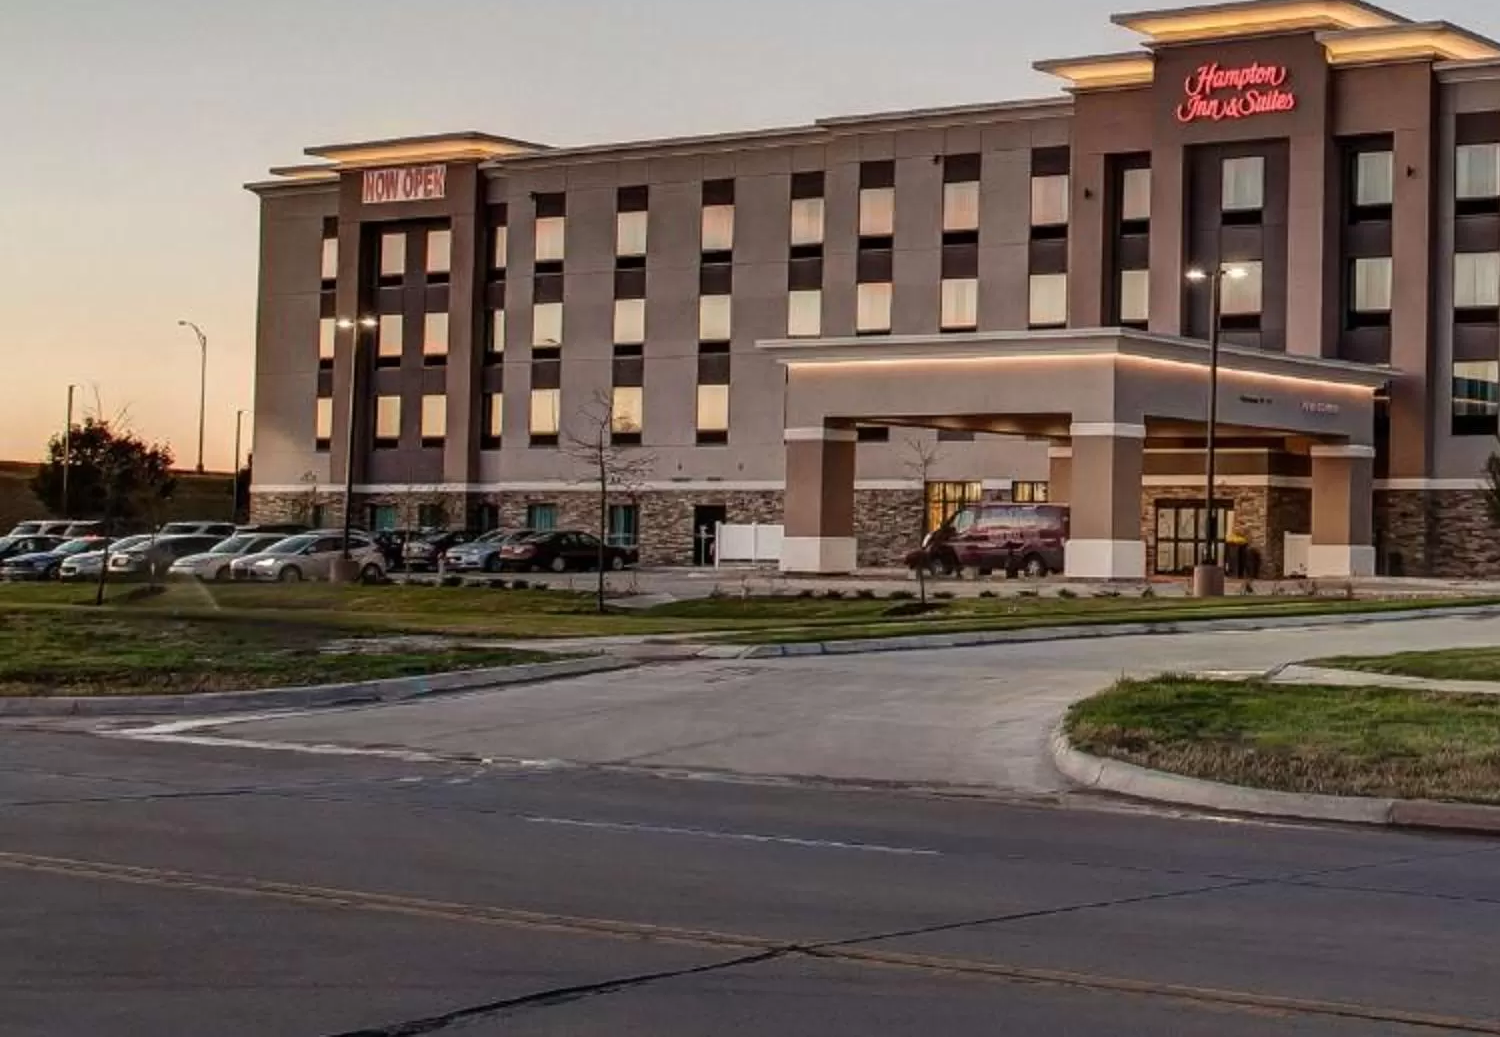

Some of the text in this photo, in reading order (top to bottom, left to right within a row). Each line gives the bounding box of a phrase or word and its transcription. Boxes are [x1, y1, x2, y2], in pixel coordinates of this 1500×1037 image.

[1185, 62, 1286, 96] Hampton
[1177, 94, 1228, 121] Inn
[1239, 89, 1294, 114] Suites
[365, 166, 444, 201] NOW OPEN
